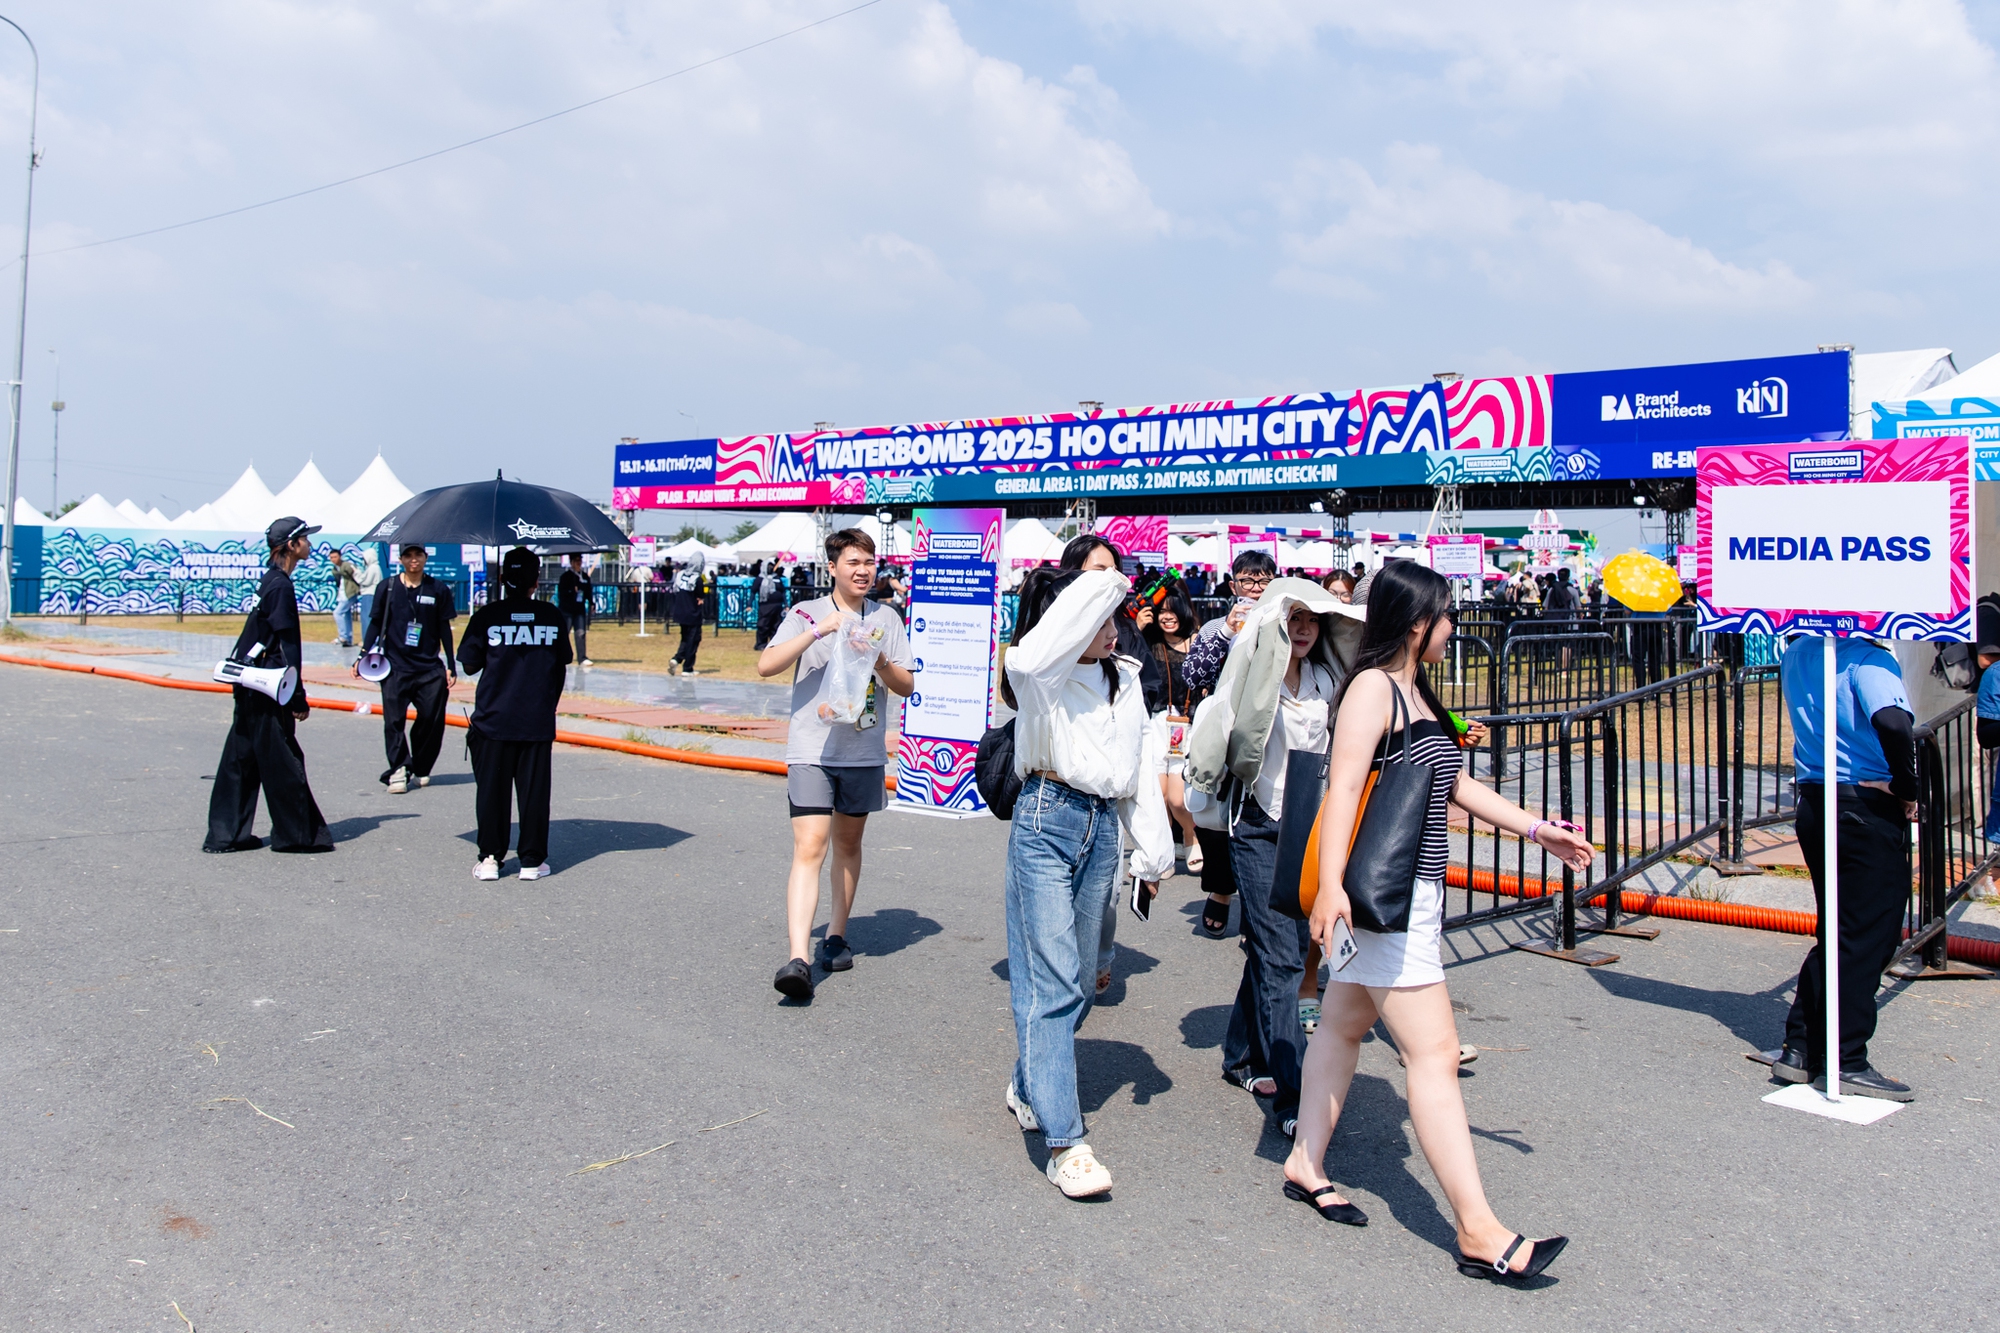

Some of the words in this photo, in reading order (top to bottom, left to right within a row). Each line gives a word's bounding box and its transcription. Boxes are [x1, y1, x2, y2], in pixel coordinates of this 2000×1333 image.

[1635, 390, 1679, 406] Brand
[1635, 403, 1711, 419] Architects
[815, 431, 975, 470] WATERBOMB
[978, 426, 1053, 462] 2025
[1059, 424, 1106, 457] HO
[1108, 420, 1161, 454] CHI
[1163, 413, 1258, 451] MINH
[1263, 407, 1346, 446] CITY
[1467, 459, 1508, 468] WATERBOMB
[1795, 457, 1857, 468] WATERBOMB
[995, 478, 1041, 494] GENERAL
[1086, 475, 1110, 491] DAY
[1154, 471, 1179, 488] DAY
[1215, 468, 1273, 486] DAYTIME
[1274, 464, 1338, 484] CHECK-IN
[686, 489, 714, 503] SPLASH
[738, 487, 767, 502] SPLASH
[768, 486, 808, 501] ECONOMY
[933, 539, 978, 549] WATERBOMB
[1729, 536, 1833, 561] MEDIA
[1841, 536, 1931, 562] PASS
[182, 553, 260, 567] WATERBOMB
[169, 566, 189, 579] HO
[189, 566, 210, 579] CHI
[210, 566, 244, 579] MINH
[487, 625, 559, 647] STAFF
